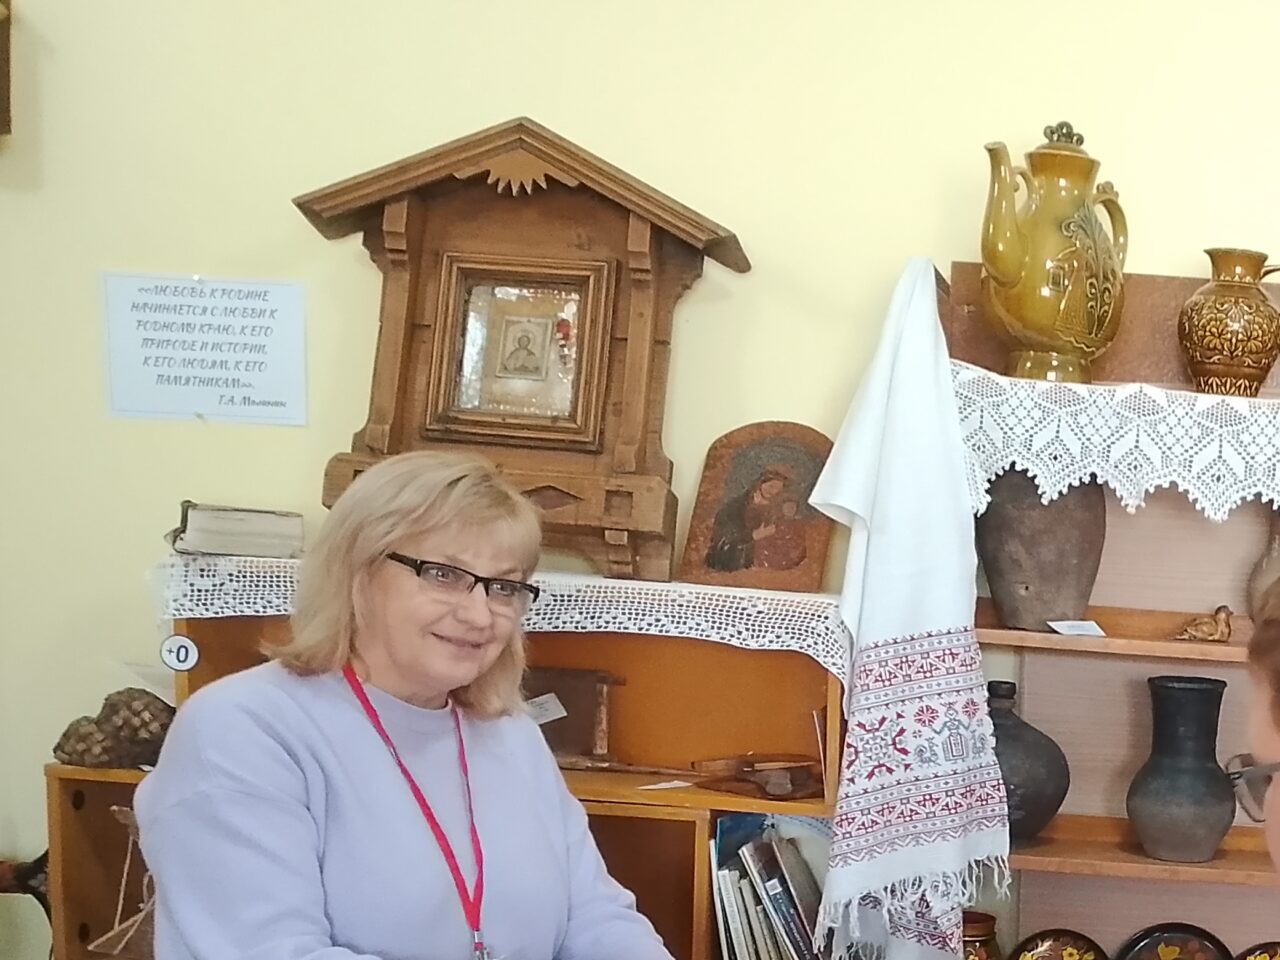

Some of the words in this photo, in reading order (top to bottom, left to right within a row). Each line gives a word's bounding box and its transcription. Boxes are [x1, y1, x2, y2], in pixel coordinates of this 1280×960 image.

[209, 287, 219, 300] К
[220, 288, 270, 302] РОДИНЕ
[130, 302, 208, 317] НАЧИНАЕТСЯ
[210, 304, 219, 317] С
[219, 306, 267, 320] ЛЮБВИ
[268, 308, 278, 320] К
[136, 320, 196, 333] РОДНОМУ
[239, 324, 249, 337] К
[250, 325, 274, 338] ЕГО
[141, 338, 198, 352] ПРИРОДЕ
[199, 340, 209, 352] И
[142, 356, 153, 367] К
[153, 356, 177, 369] ЕГО
[233, 360, 244, 372] К
[245, 361, 268, 373] ЕГО
